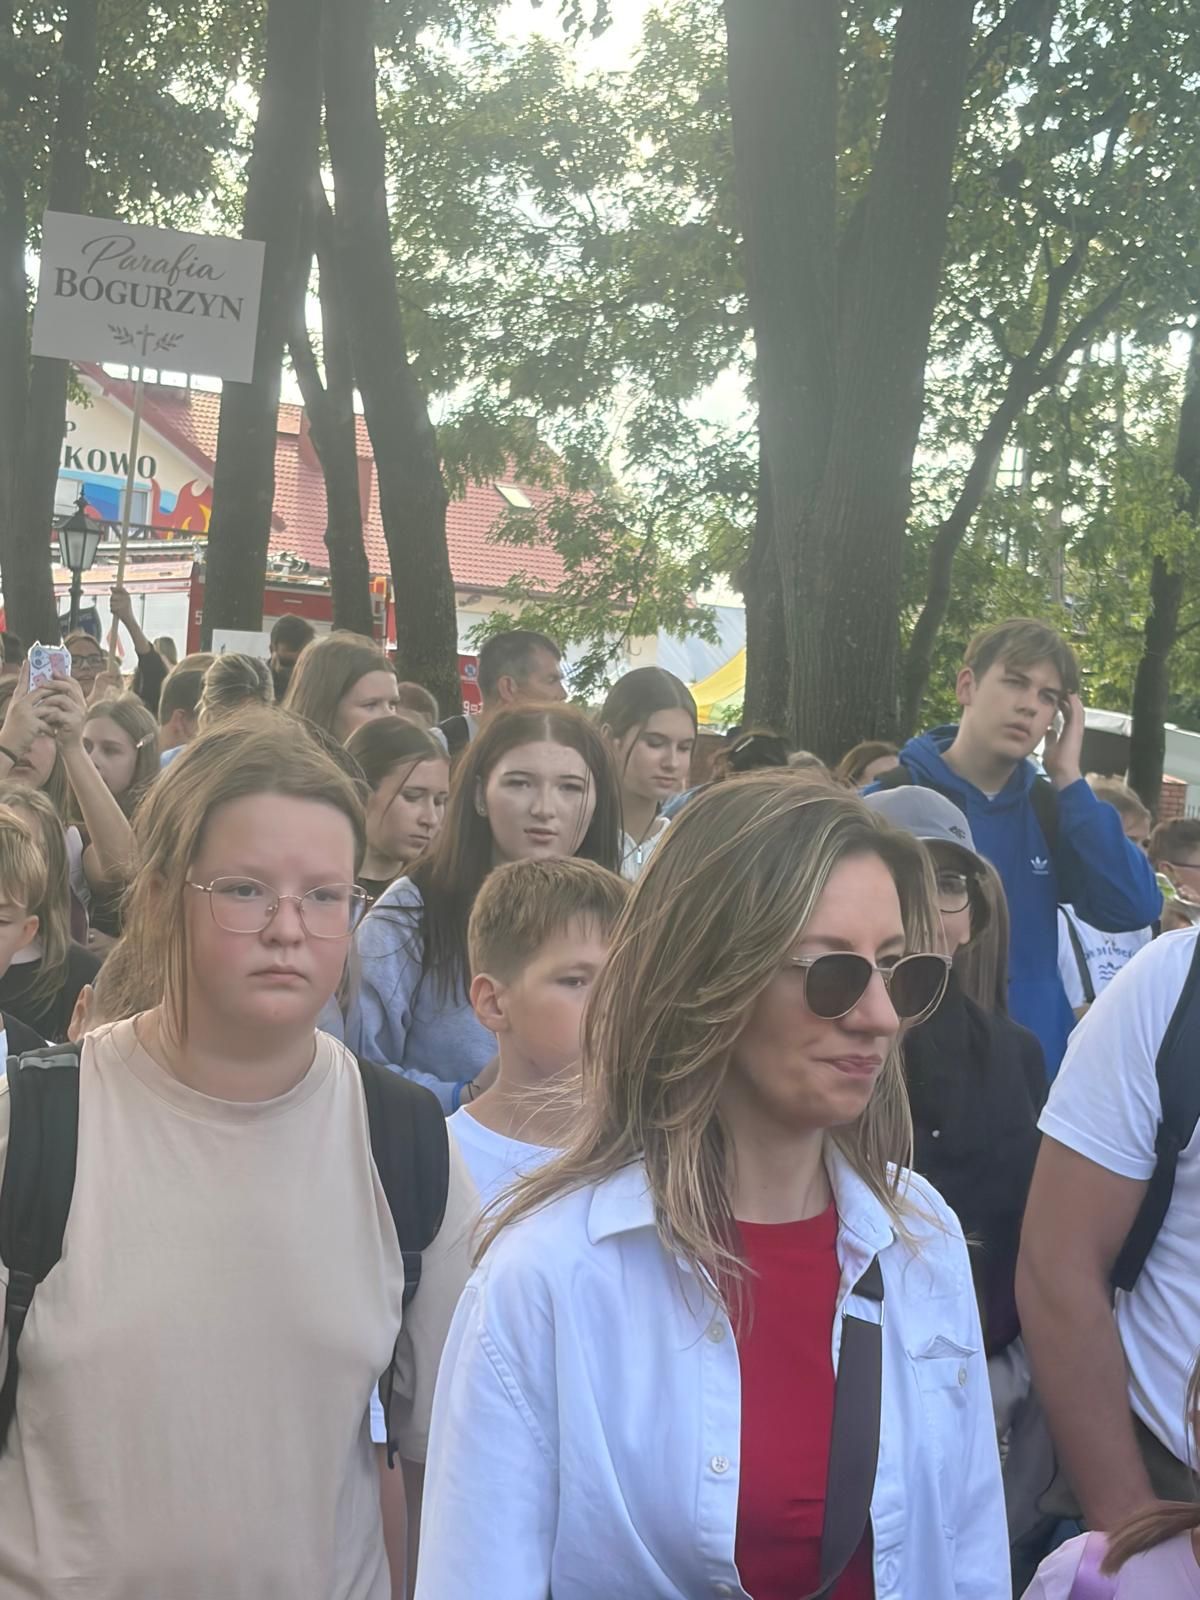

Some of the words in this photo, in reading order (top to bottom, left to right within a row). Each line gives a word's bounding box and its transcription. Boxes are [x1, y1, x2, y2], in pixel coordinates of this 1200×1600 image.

[81, 235, 226, 286] Parafia
[54, 267, 244, 322] BOGURZYN
[60, 445, 157, 479] KOWO
